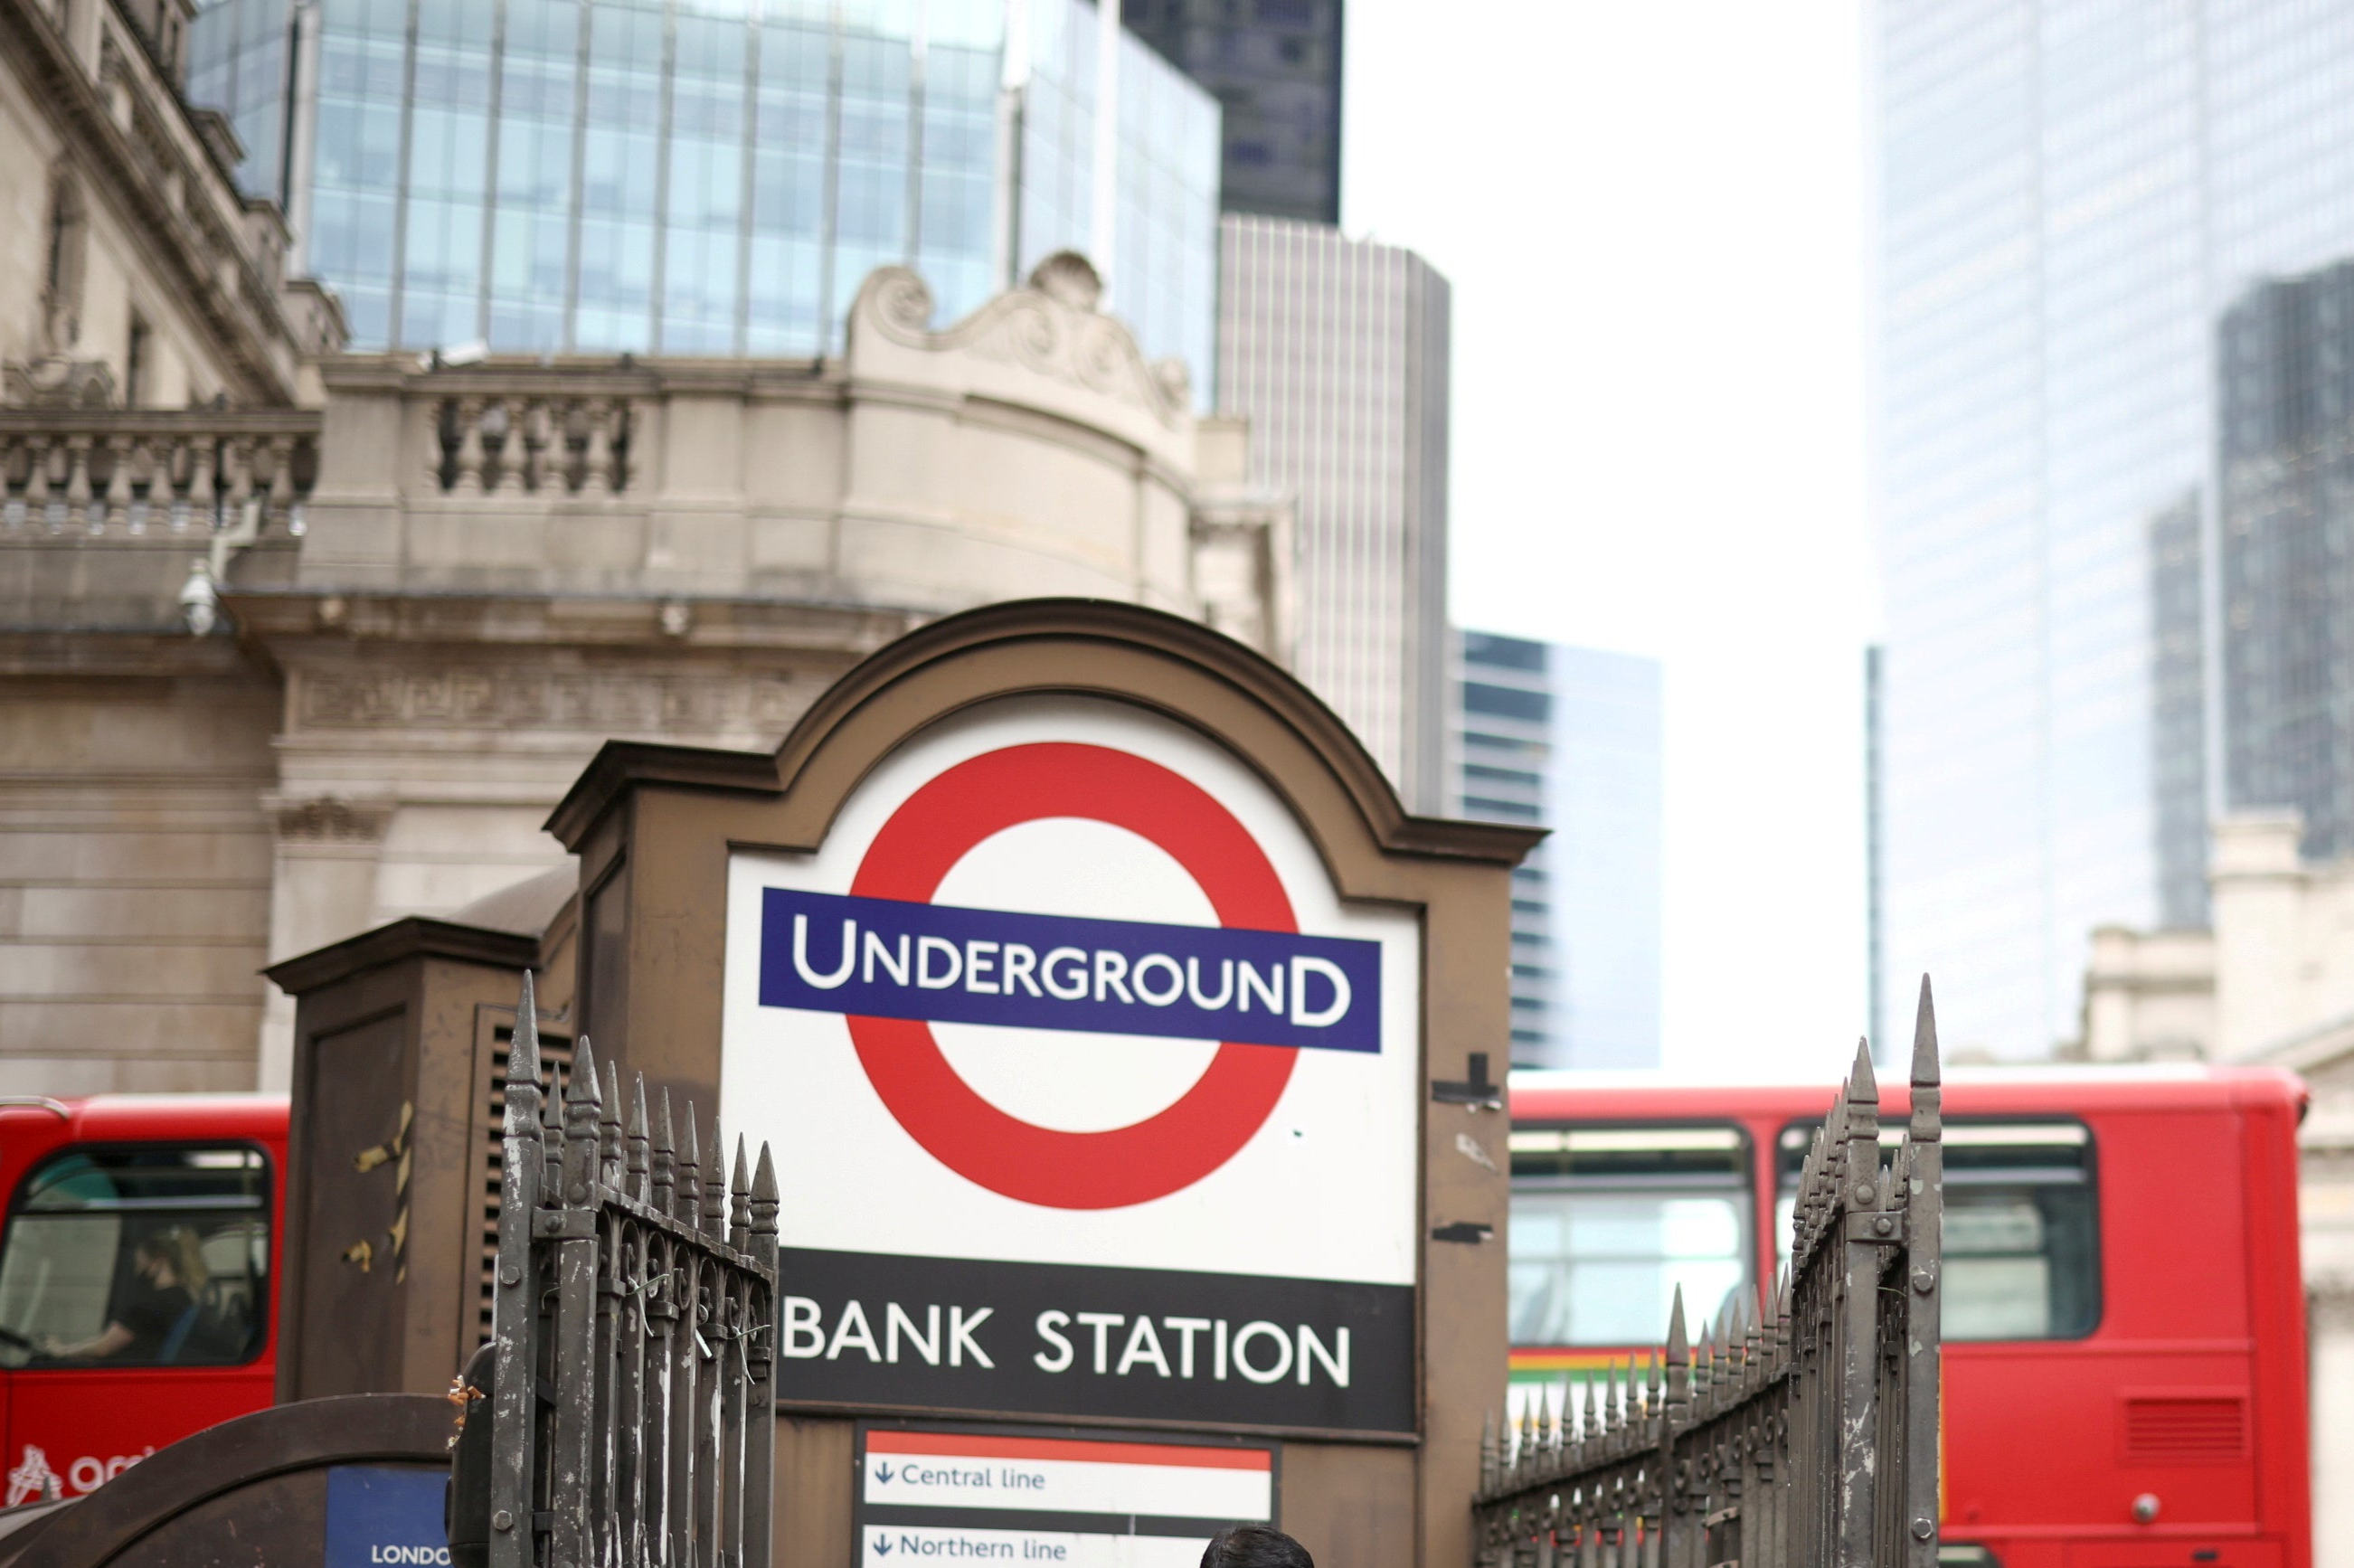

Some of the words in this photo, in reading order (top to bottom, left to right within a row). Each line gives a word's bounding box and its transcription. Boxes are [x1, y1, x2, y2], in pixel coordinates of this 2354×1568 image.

[792, 913, 1352, 1027] UNDERGROUND
[781, 1296, 995, 1369] BANK
[1034, 1309, 1350, 1388] STATION
[901, 1463, 992, 1488] Central
[1002, 1468, 1046, 1490] line
[900, 1535, 1015, 1559] Northern
[1024, 1539, 1067, 1561] line
